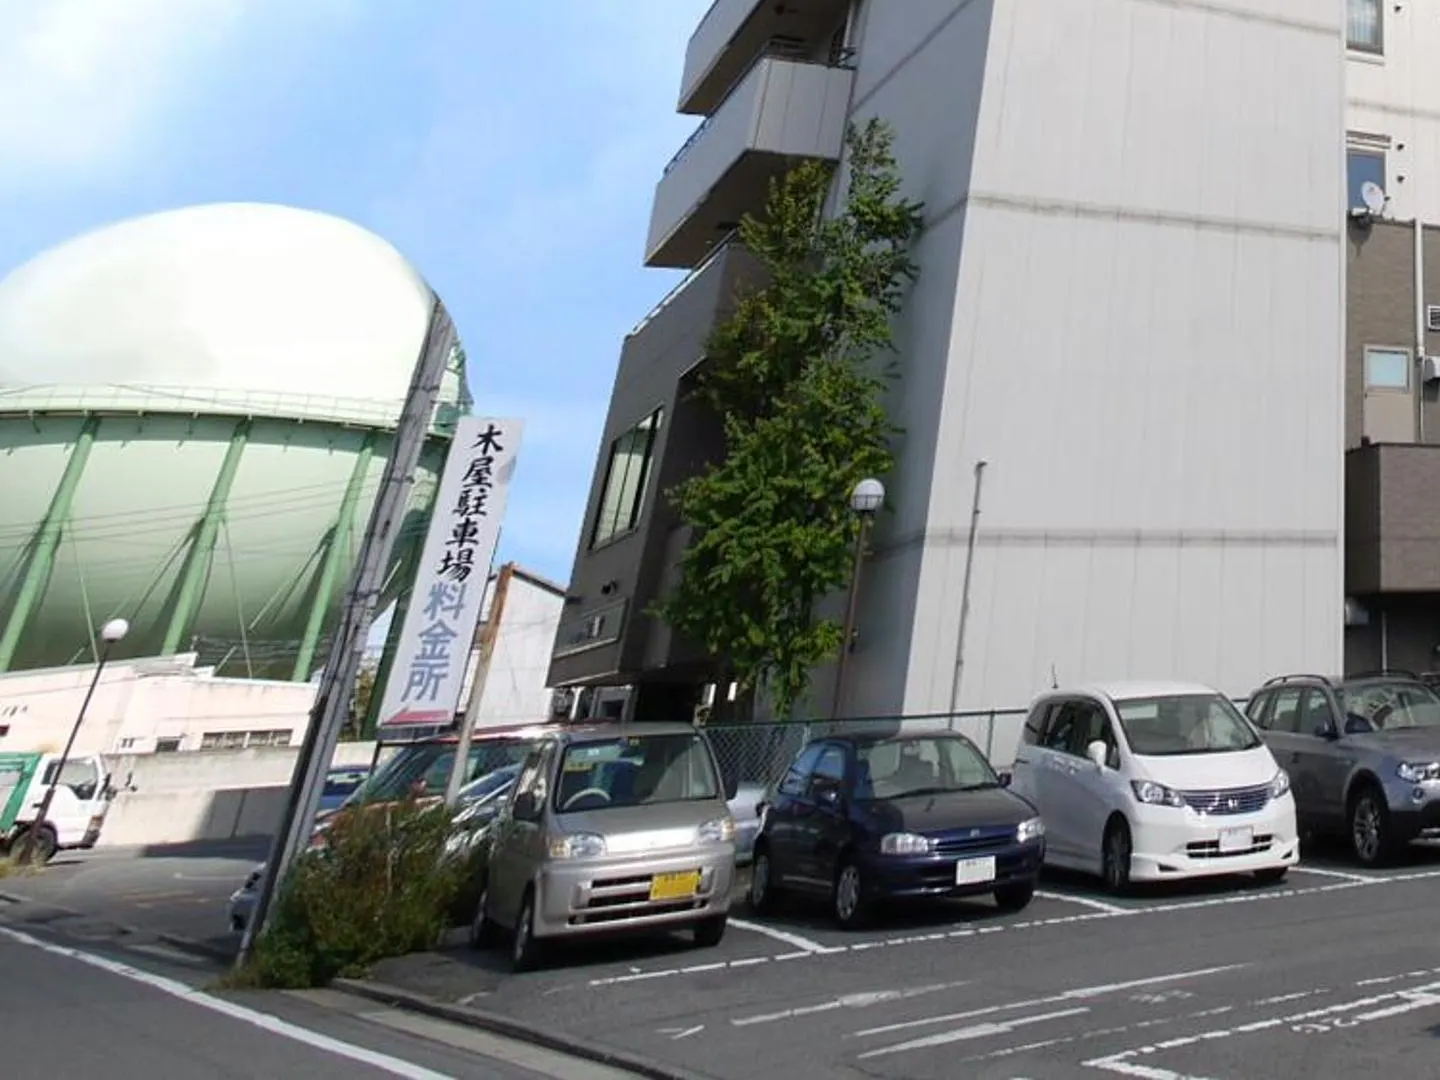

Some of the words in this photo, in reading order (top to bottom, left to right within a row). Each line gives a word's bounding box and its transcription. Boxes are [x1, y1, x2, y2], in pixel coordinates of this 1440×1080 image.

[438, 424, 503, 582] 木屋駐車場
[401, 581, 466, 702] 料金所
